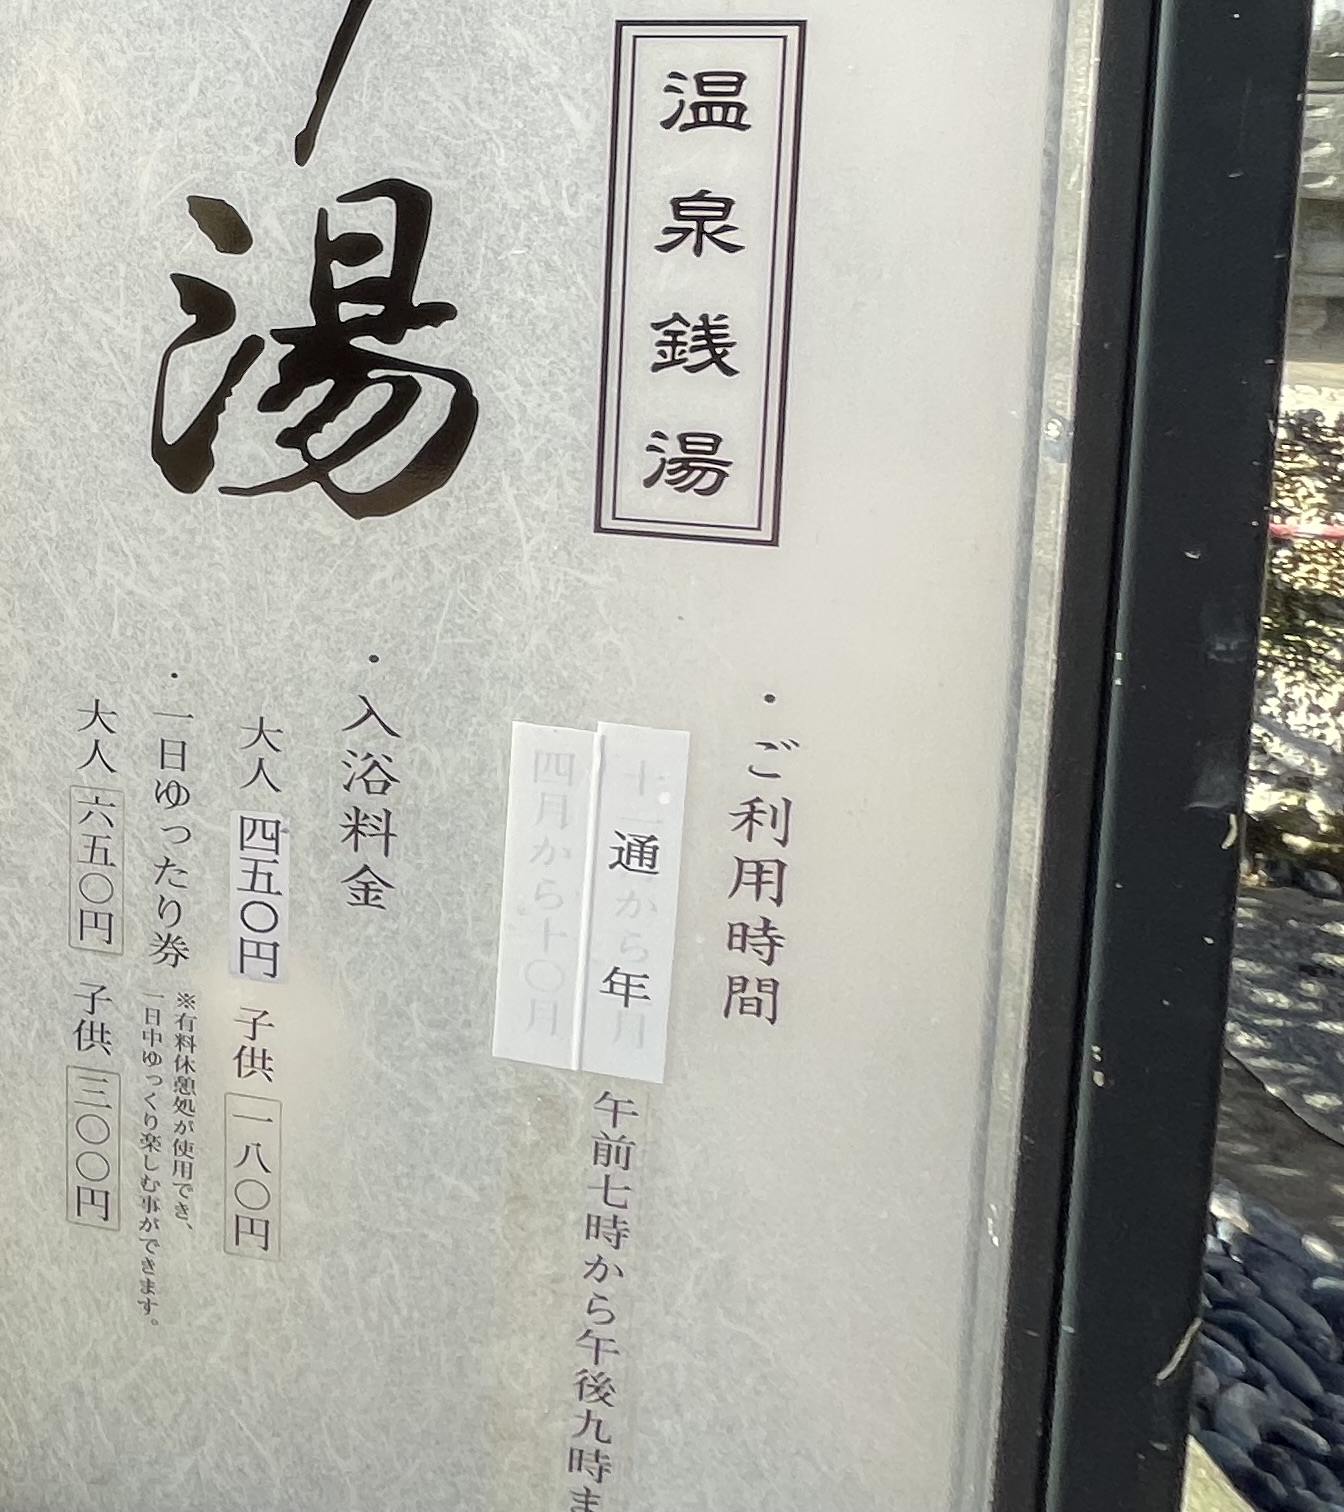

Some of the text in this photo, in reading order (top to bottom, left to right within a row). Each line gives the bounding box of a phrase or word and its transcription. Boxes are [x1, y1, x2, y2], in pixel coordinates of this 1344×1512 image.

[643, 69, 752, 498] 温泉銭湯
[76, 698, 117, 774] 大人
[239, 716, 284, 794] 大人
[73, 982, 113, 1056] 子供
[233, 1006, 275, 1083] 子供
